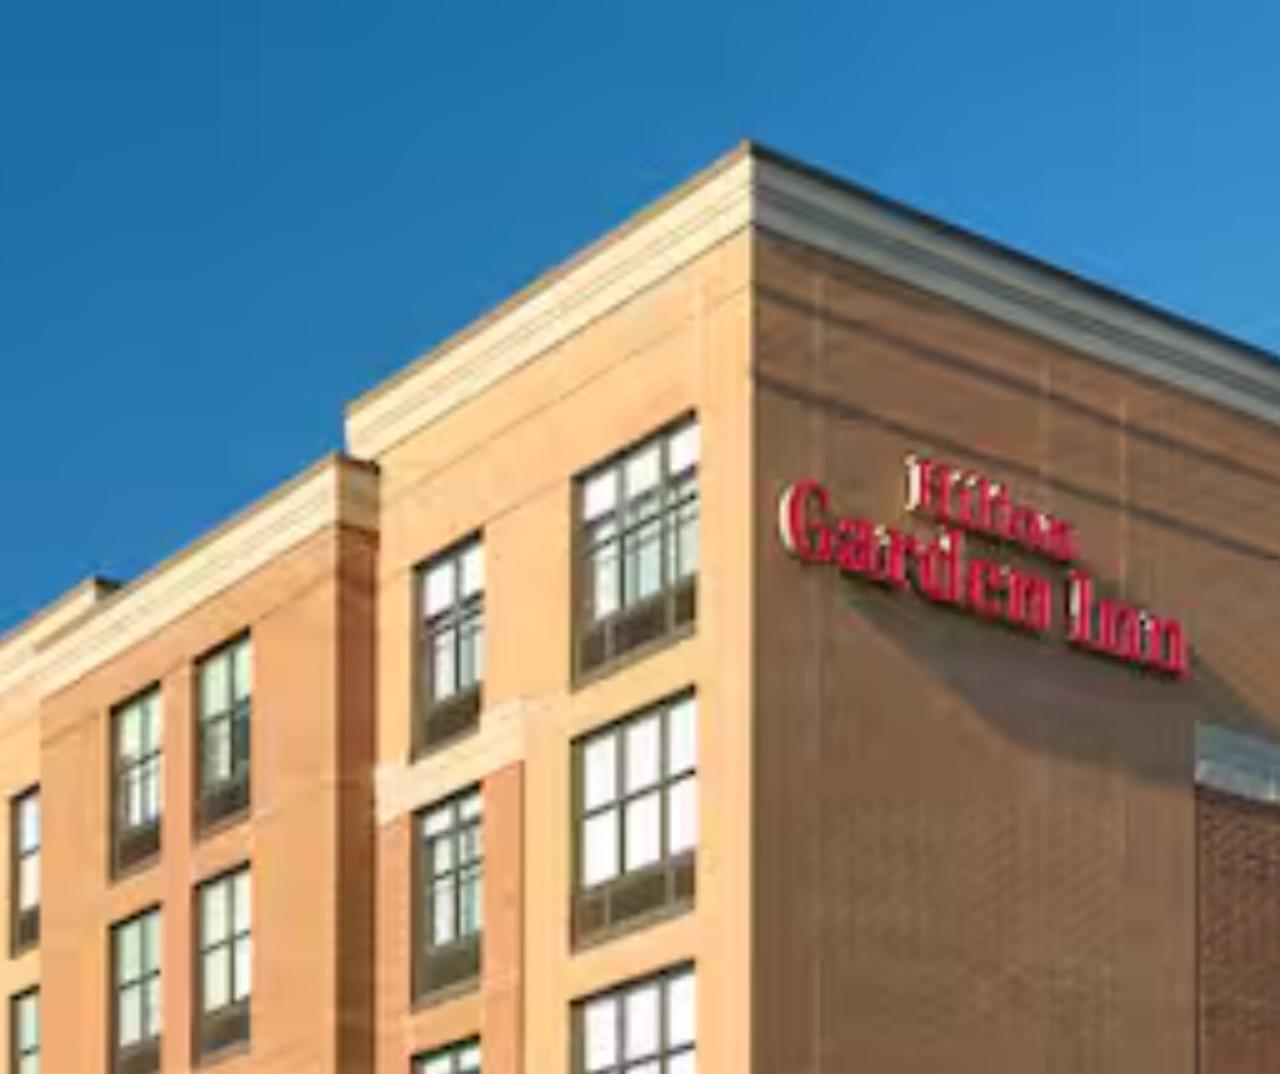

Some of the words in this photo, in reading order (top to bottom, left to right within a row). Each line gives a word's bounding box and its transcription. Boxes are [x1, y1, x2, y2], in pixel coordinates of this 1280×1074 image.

[779, 479, 1052, 630] Garden
[1069, 569, 1189, 678] Inn
[905, 455, 1079, 560] Hilton
